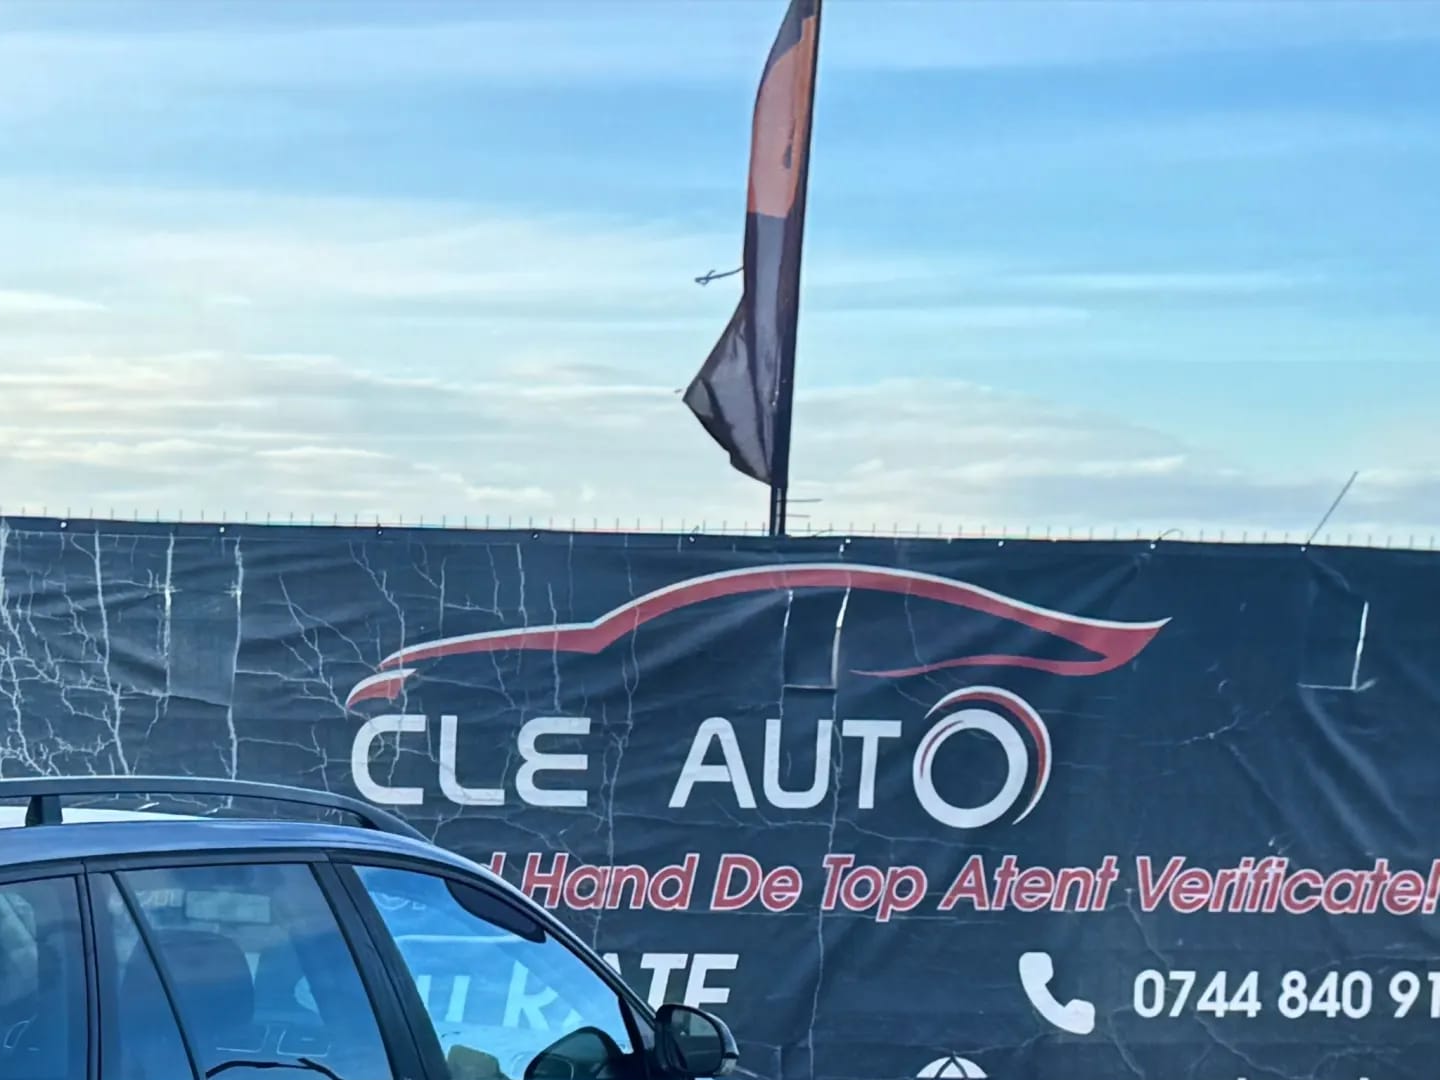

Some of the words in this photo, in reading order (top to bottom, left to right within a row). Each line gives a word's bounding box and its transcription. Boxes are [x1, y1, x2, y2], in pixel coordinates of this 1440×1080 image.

[350, 713, 591, 807] CLE
[668, 708, 1029, 829] AUTO
[520, 852, 700, 911] Hand
[709, 855, 803, 912] De
[821, 854, 927, 922] Top
[937, 855, 1119, 911] Atent
[1136, 856, 1440, 915] Verificate!
[1133, 971, 1261, 1019] 0744
[1278, 971, 1373, 1019] 840
